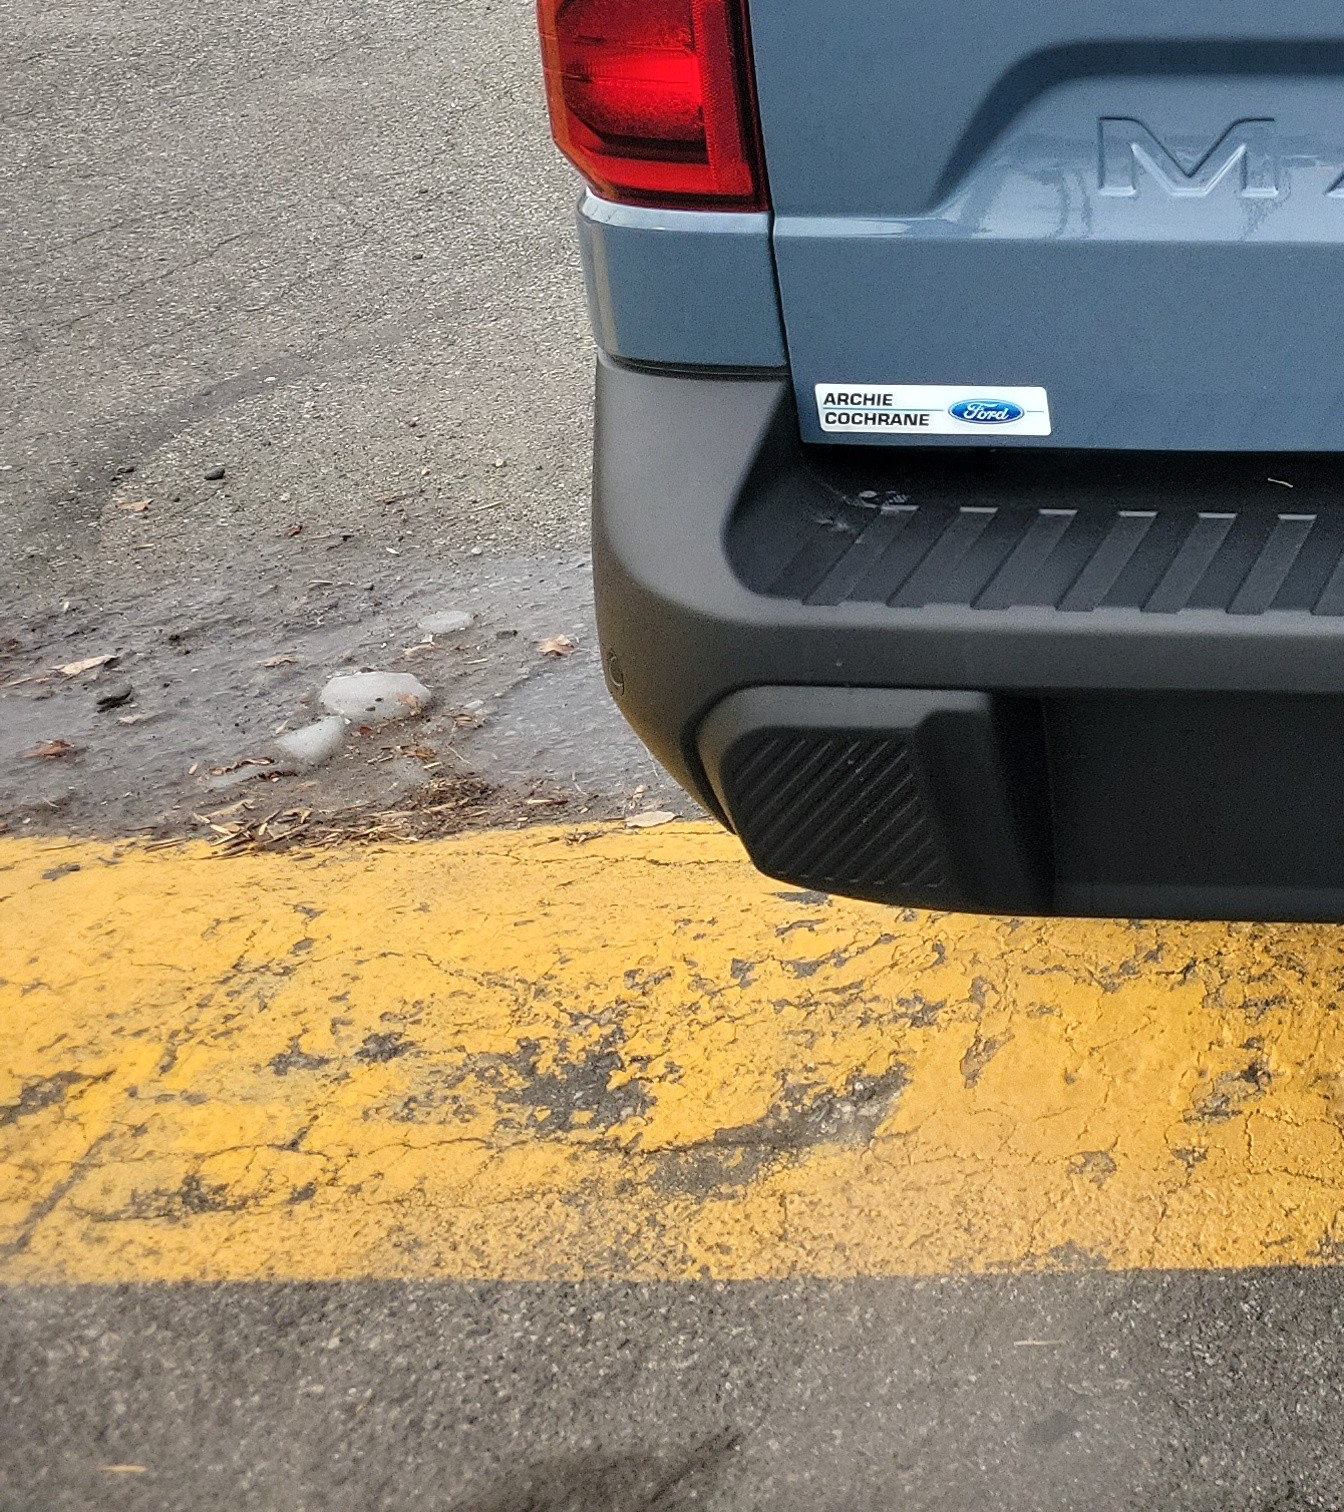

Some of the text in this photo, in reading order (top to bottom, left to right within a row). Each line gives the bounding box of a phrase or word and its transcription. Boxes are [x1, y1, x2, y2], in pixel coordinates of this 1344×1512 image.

[823, 392, 894, 406] ARCHIE
[825, 411, 930, 426] COCHRANE
[963, 402, 1010, 420] Ford
